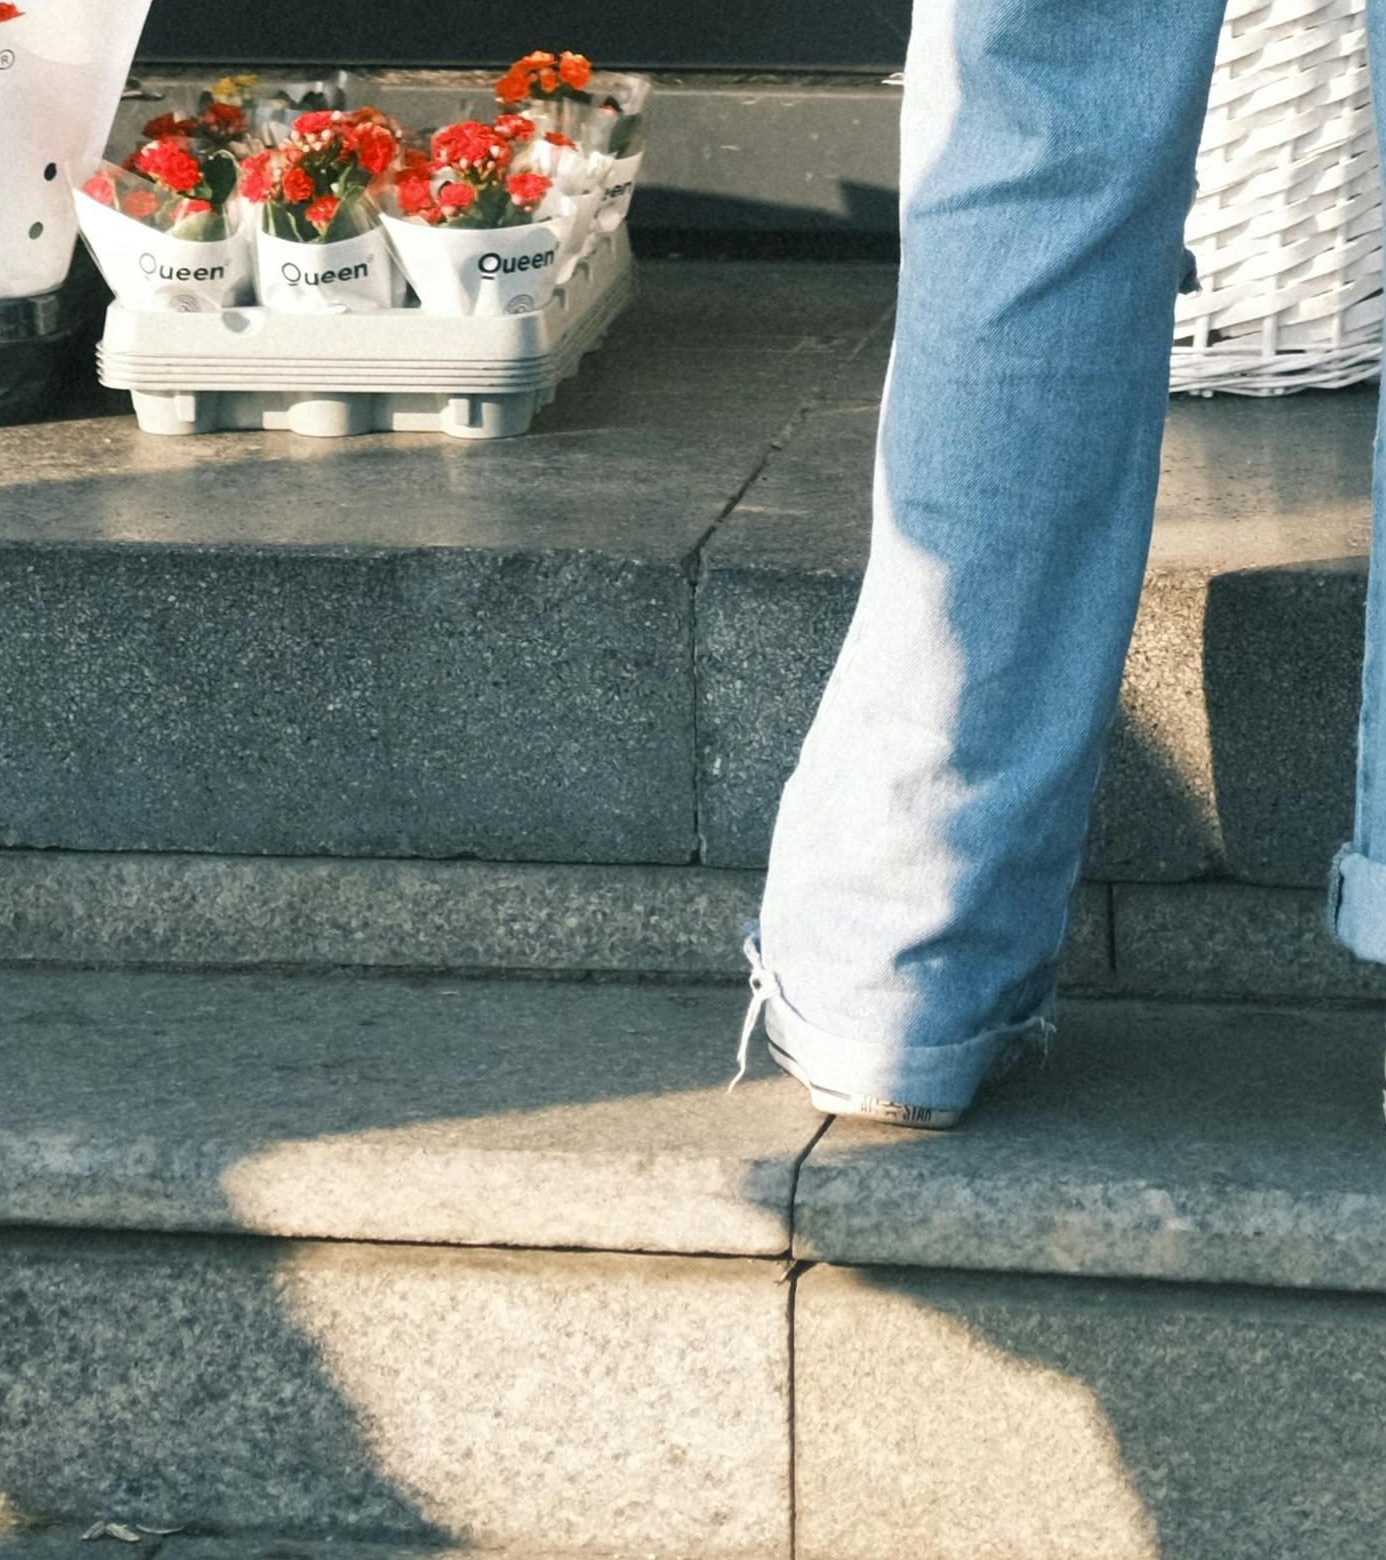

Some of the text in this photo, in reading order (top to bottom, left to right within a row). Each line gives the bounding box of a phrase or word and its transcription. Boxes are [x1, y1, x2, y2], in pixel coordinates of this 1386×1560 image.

[138, 252, 225, 282] Queen
[281, 261, 369, 287] Queen
[477, 249, 556, 281] Queen
